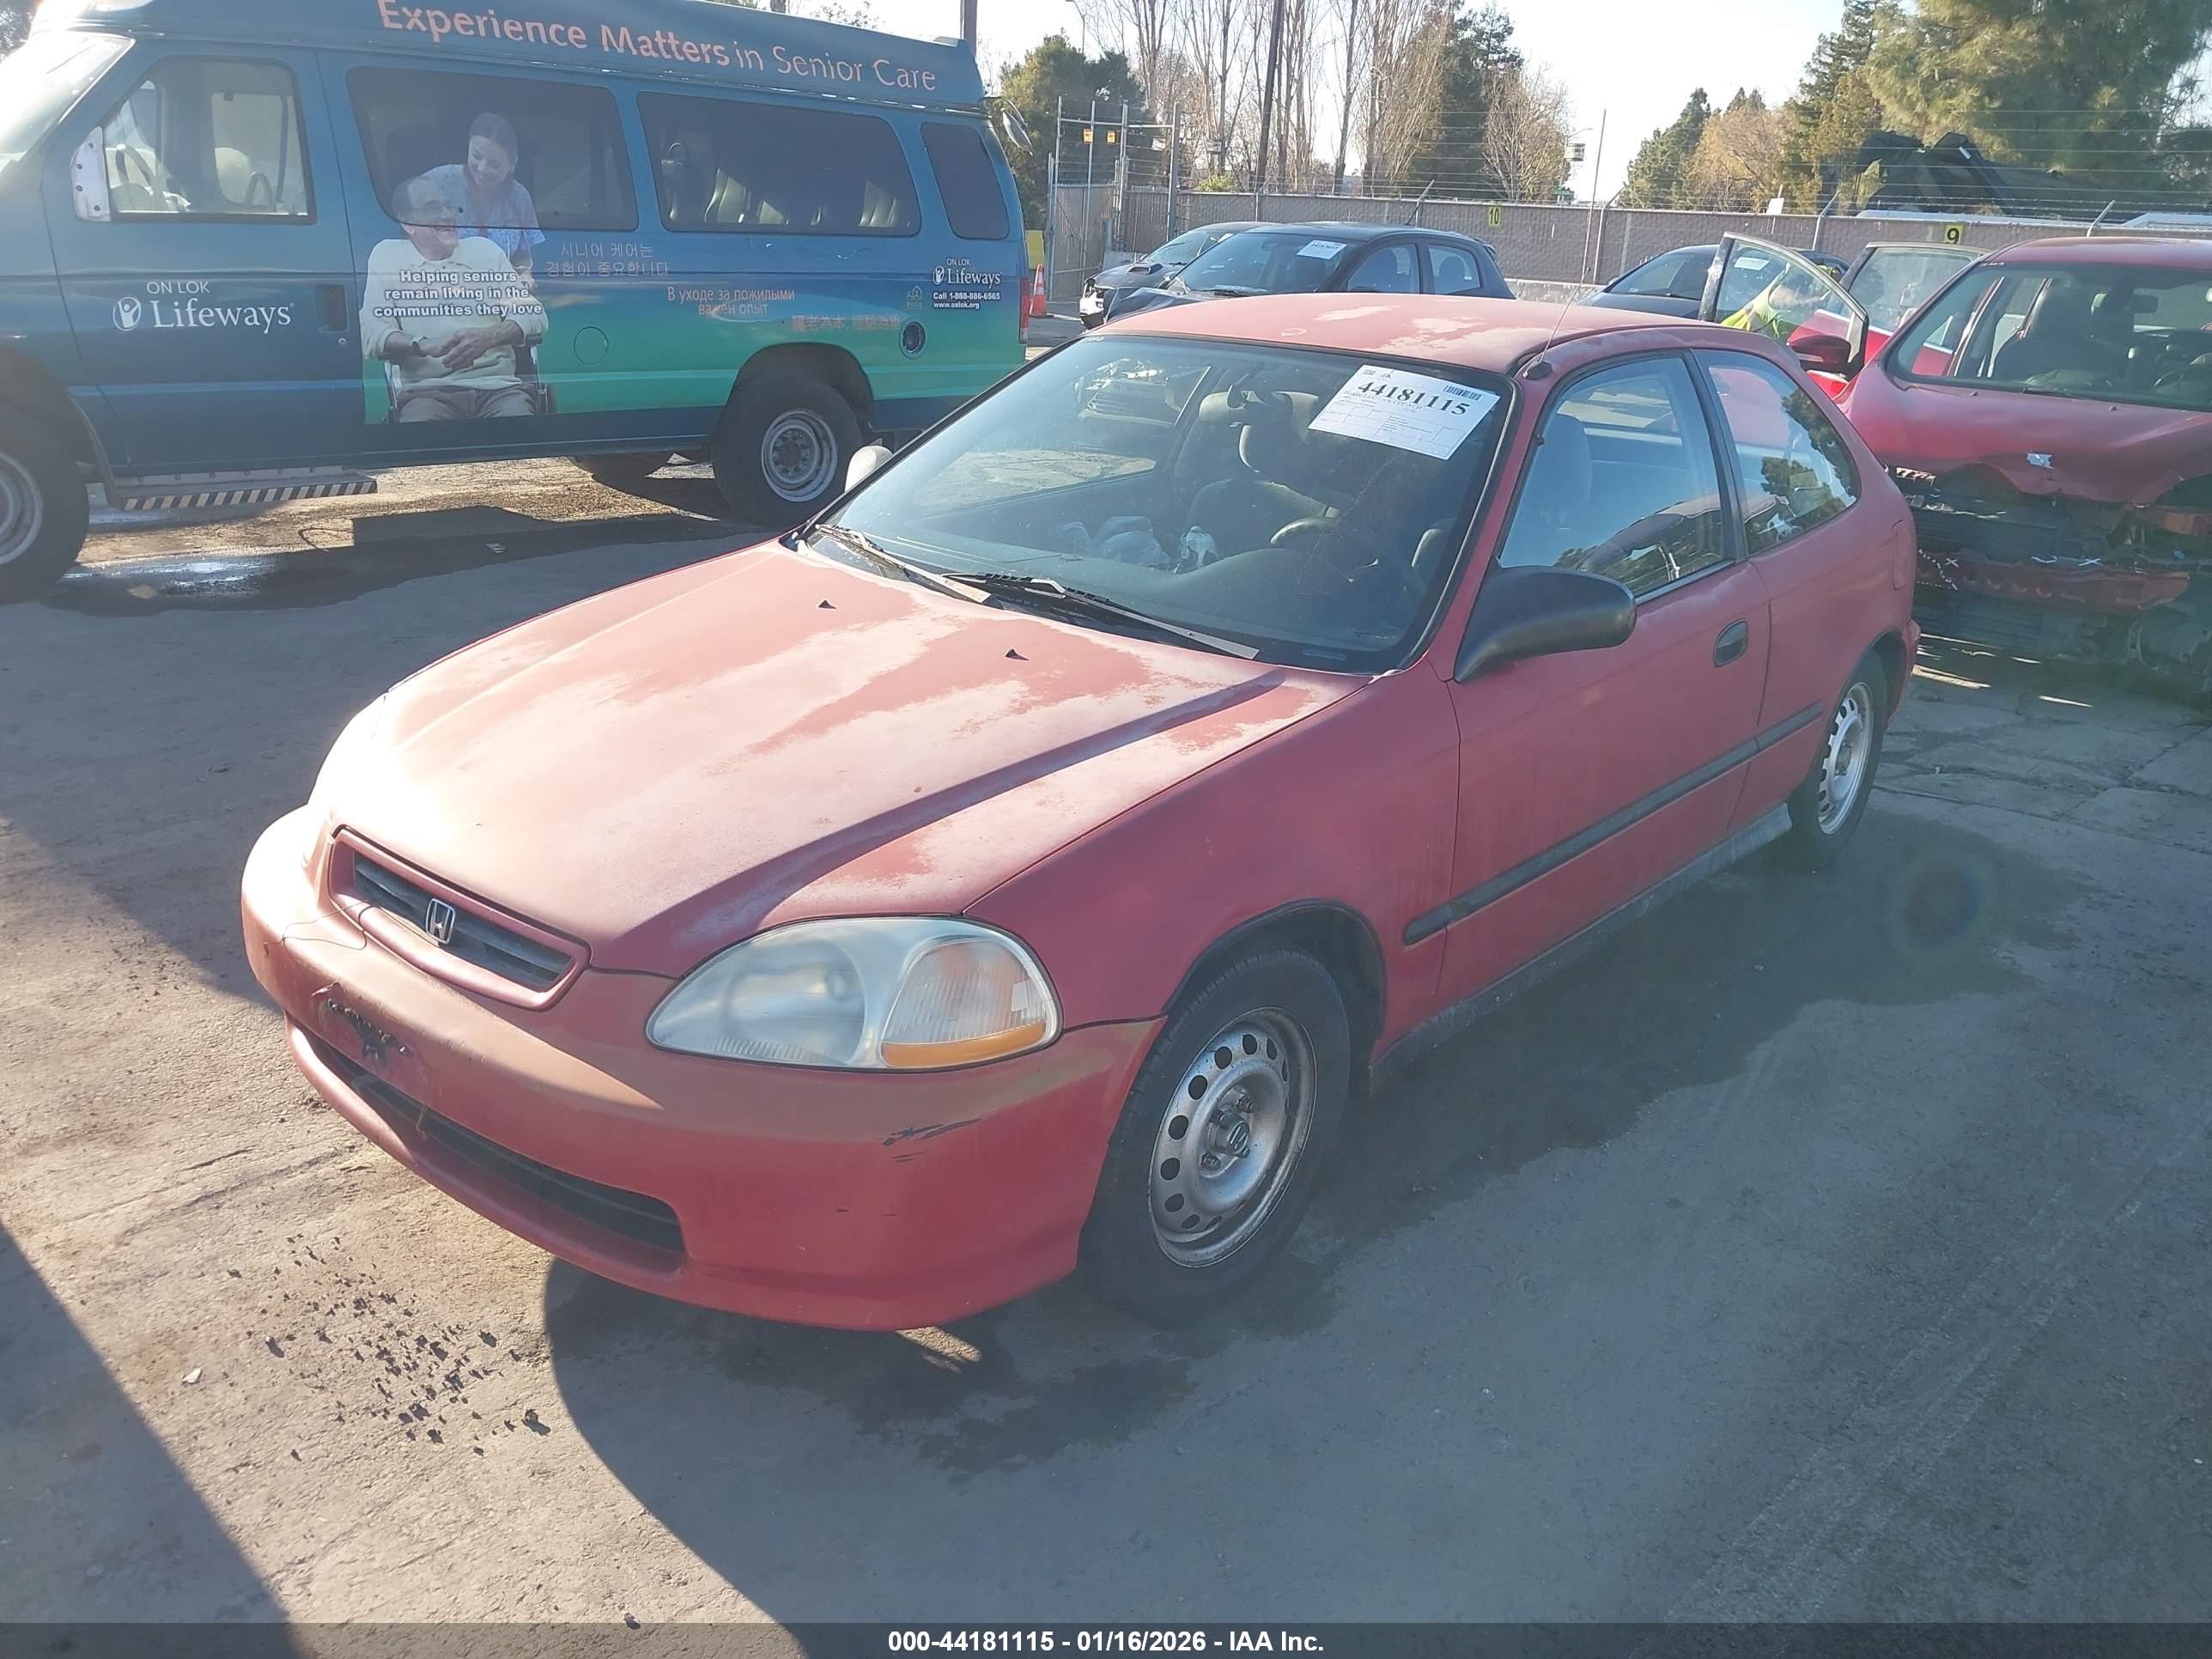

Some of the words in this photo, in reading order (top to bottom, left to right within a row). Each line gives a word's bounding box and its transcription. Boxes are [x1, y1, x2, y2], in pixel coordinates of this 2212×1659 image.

[377, 0, 587, 49] Experience
[601, 24, 729, 66] Matters
[734, 40, 763, 70] in
[773, 46, 862, 82] Senior
[872, 59, 936, 91] Care
[1489, 207, 1499, 224] 10
[1947, 228, 1960, 244] 9
[562, 242, 603, 258] 시니어
[611, 242, 653, 258] 케어는
[946, 258, 957, 266] ON
[958, 258, 971, 266] LOK
[400, 270, 459, 284] Helping
[464, 270, 517, 283] seniors
[947, 267, 1000, 289] Lifeways
[146, 281, 173, 294] ON
[178, 281, 210, 294] LOK
[385, 288, 438, 299] remain
[442, 287, 483, 301] living
[488, 288, 501, 298] in
[506, 287, 529, 298] the
[667, 286, 675, 301] В
[679, 289, 714, 304] уходе
[718, 289, 730, 301] за
[734, 289, 795, 301] пожилыми
[949, 292, 1000, 301] 1-888-886-6565
[149, 298, 291, 334] Lifeways
[374, 304, 471, 317] communities
[477, 303, 508, 317] they
[513, 303, 542, 314] love
[739, 304, 769, 316] опыт
[1358, 381, 1471, 416] 44181115
